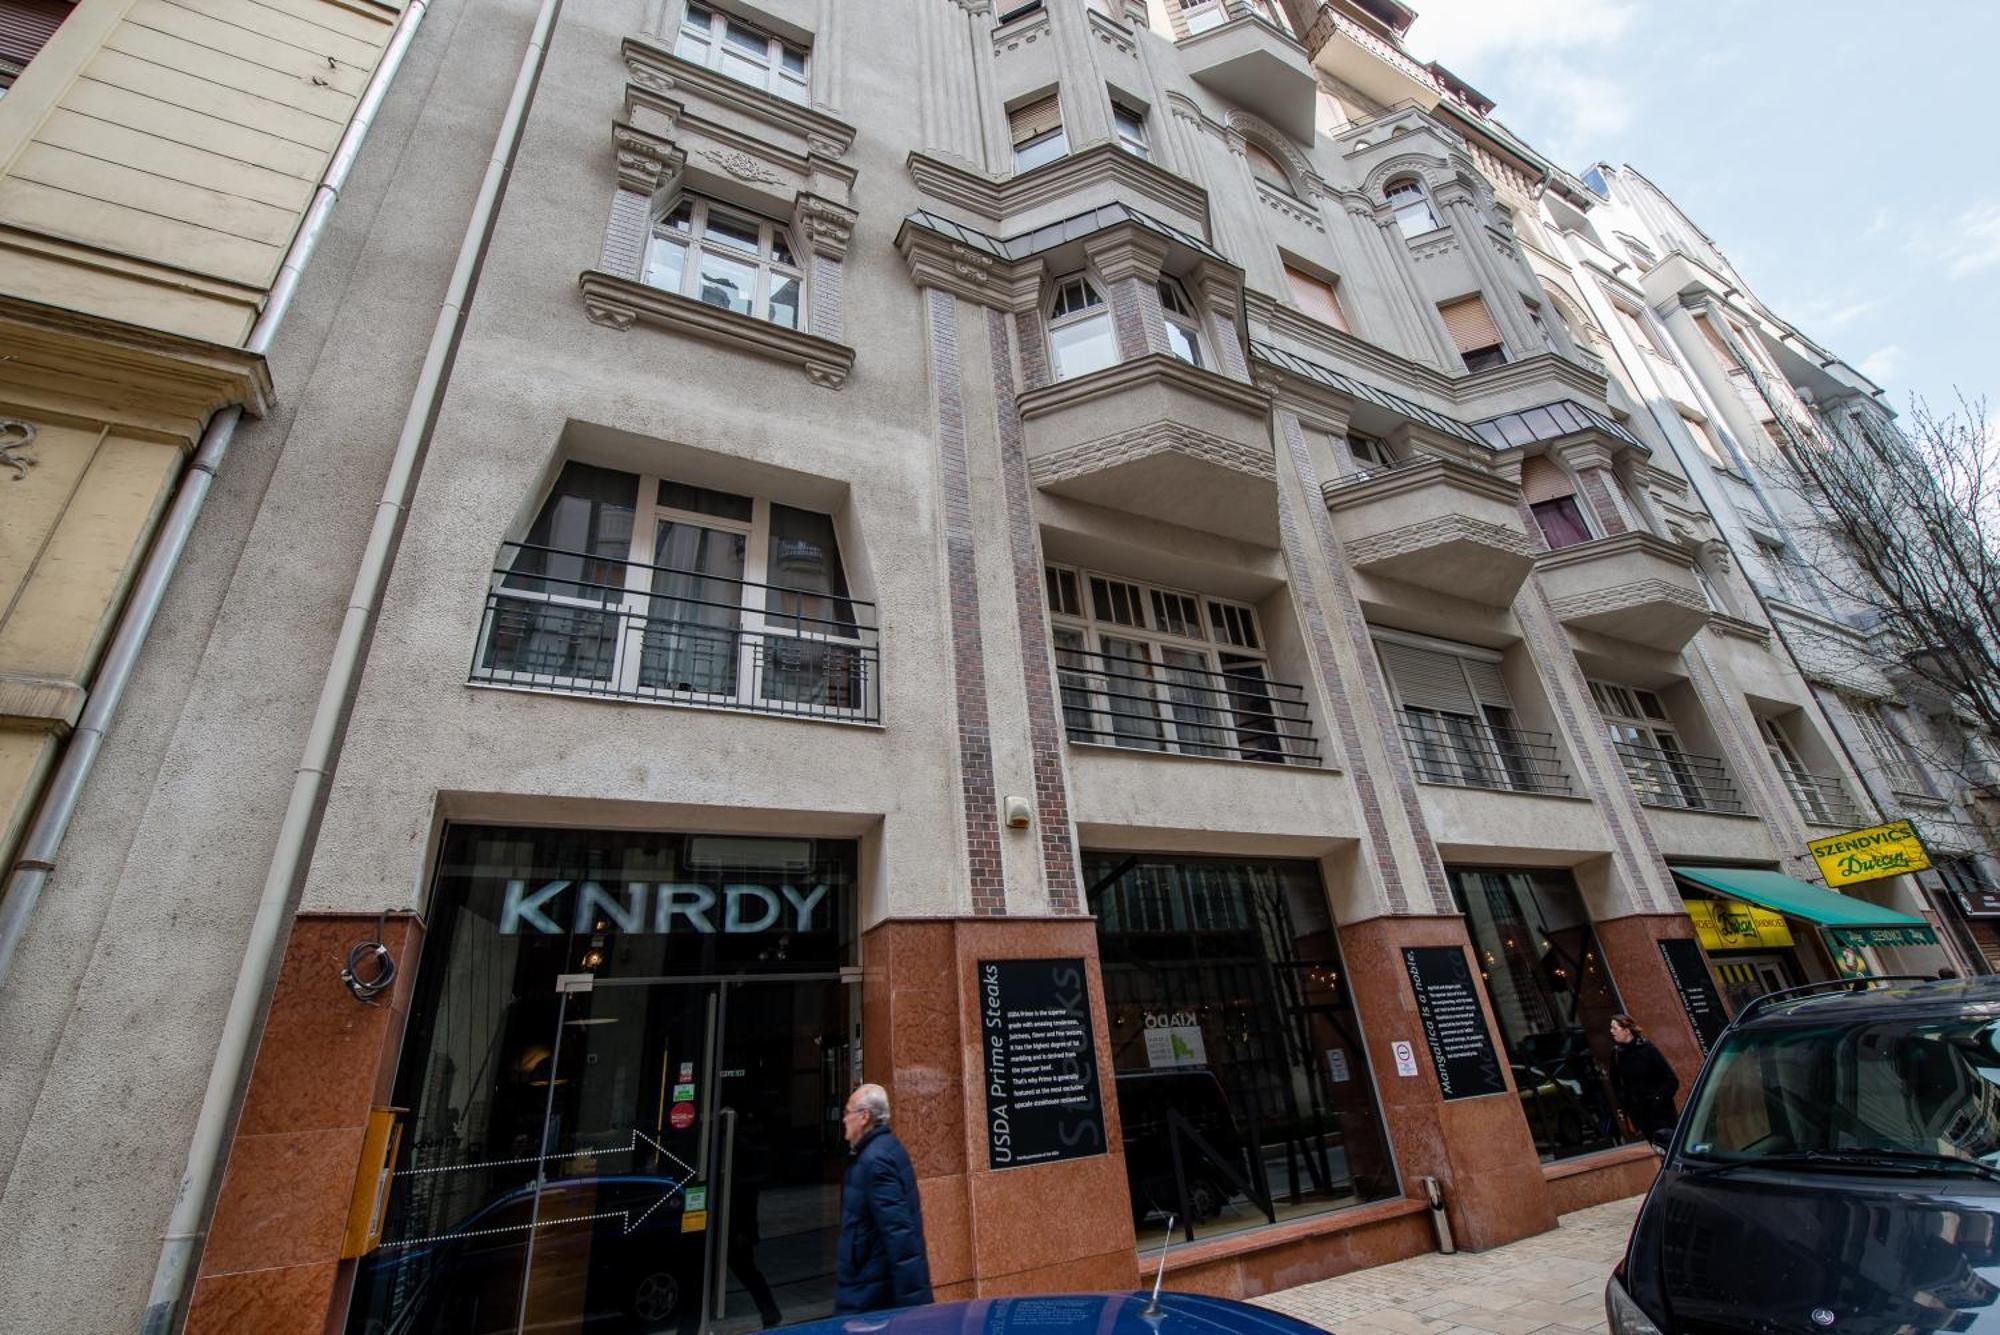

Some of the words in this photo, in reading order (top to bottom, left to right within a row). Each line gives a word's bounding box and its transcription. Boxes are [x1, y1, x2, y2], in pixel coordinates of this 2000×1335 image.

[1815, 828, 1913, 858] SZENDVICS
[499, 880, 830, 934] KNRDY
[983, 964, 1001, 1028] Steaks
[1422, 1005, 1432, 1016] is
[989, 1034, 1007, 1098] Prime
[1427, 1021, 1453, 1094] Mangalica
[994, 1104, 1012, 1163] USDA
